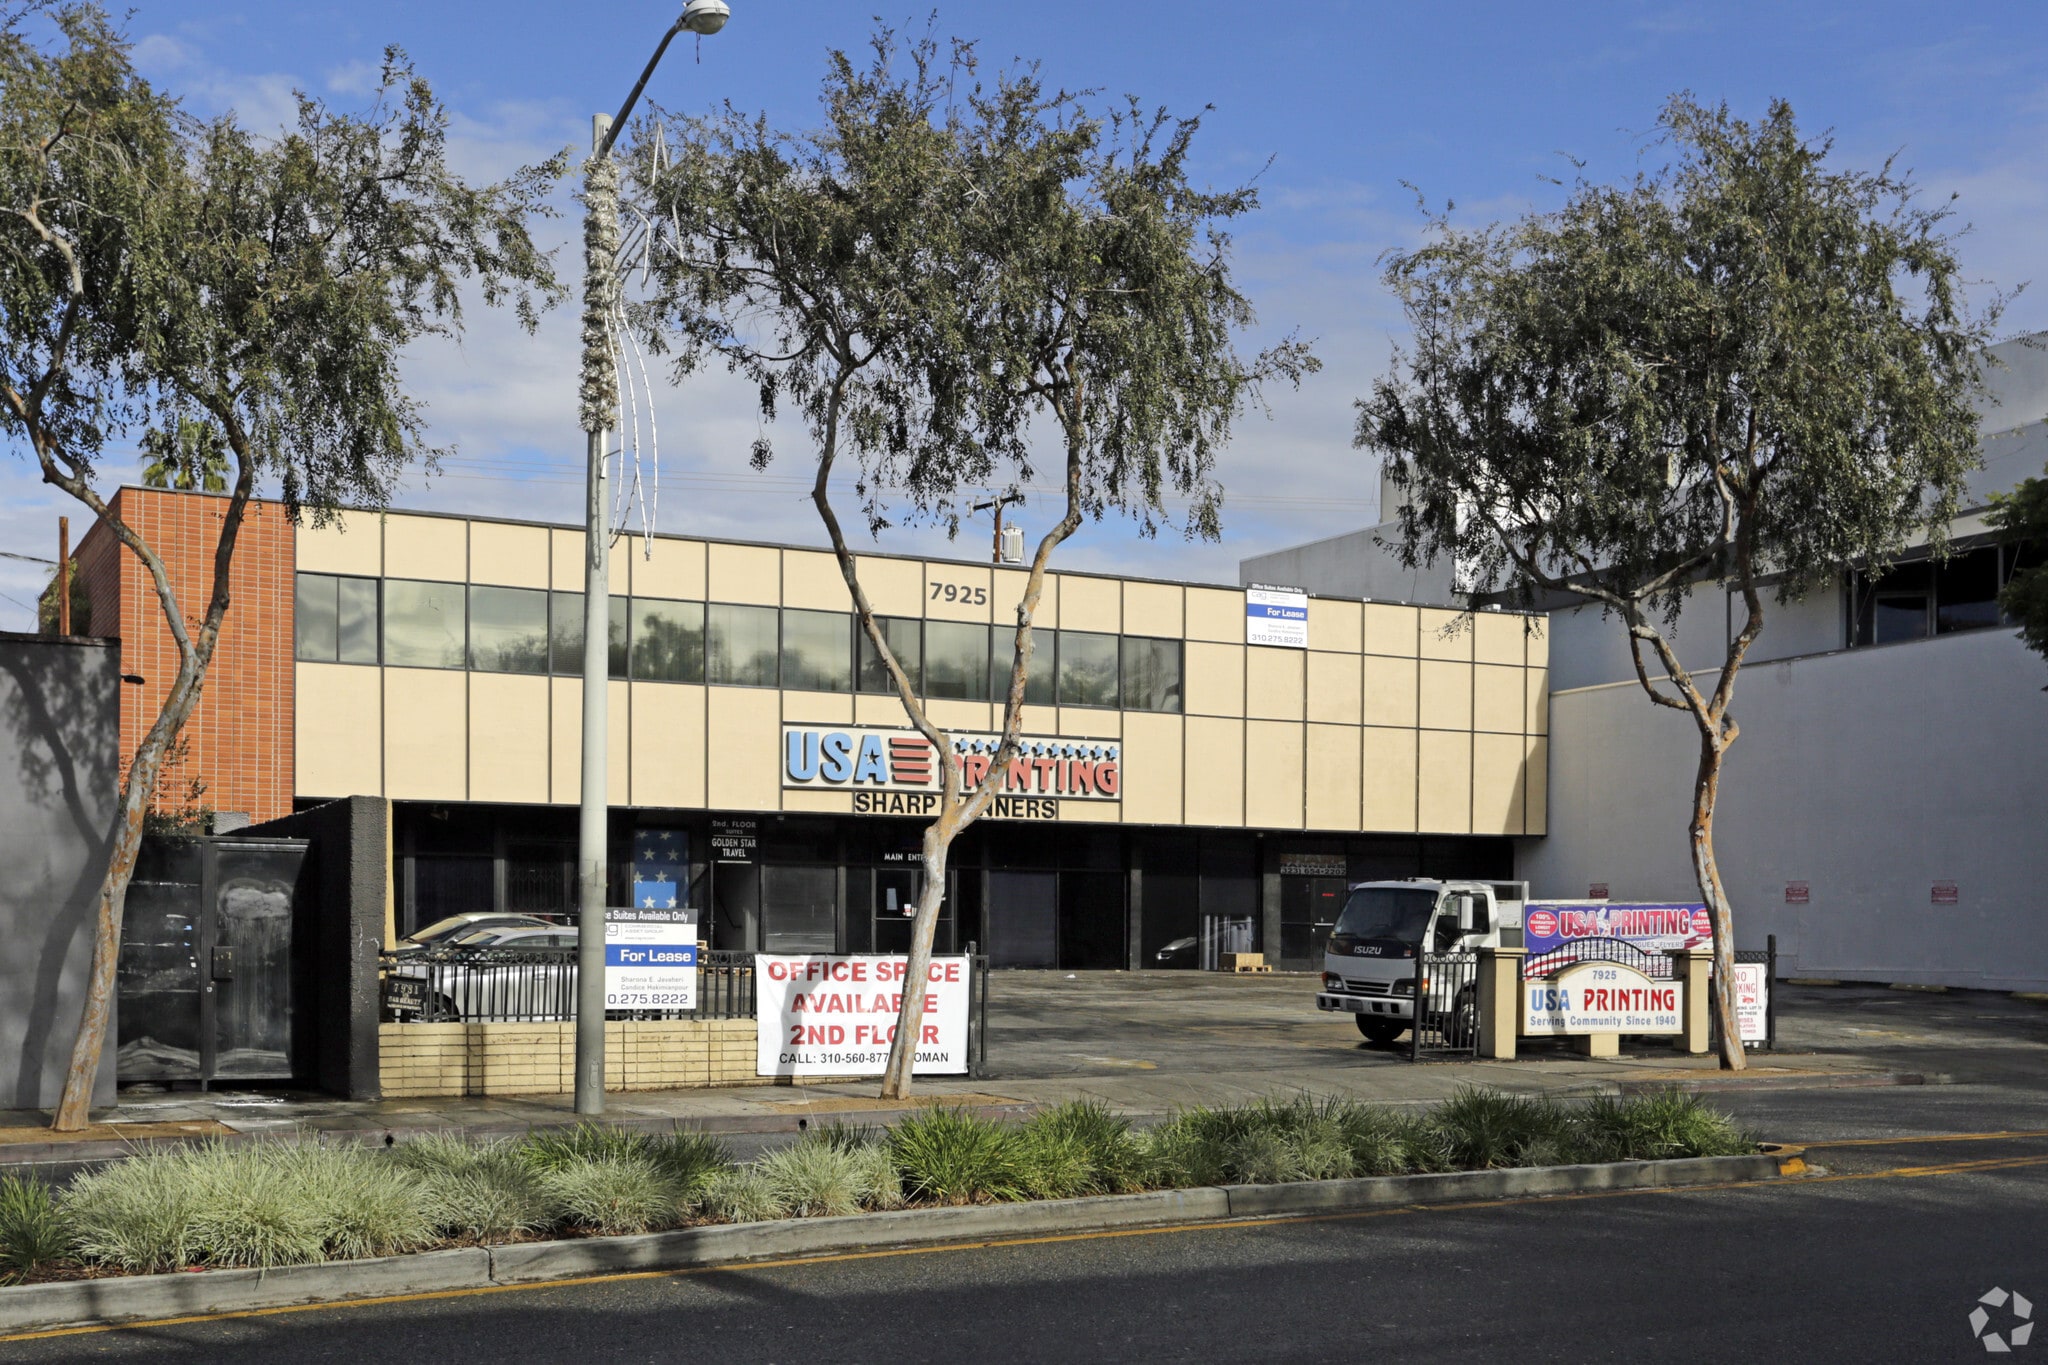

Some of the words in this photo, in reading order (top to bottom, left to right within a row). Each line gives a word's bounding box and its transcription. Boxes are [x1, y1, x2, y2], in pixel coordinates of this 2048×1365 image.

[930, 582, 986, 606] 7925
[1267, 608, 1281, 616] For
[1282, 608, 1304, 618] Lease
[787, 731, 888, 784] USA
[855, 793, 936, 814] SHARP
[712, 838, 738, 846] GOLDEN
[740, 839, 756, 848] STAR
[722, 848, 746, 857] TRAVEL
[884, 853, 903, 861] MAIN
[614, 910, 636, 920] Suites
[638, 911, 670, 920] Available
[672, 912, 688, 923] Only
[1558, 911, 1599, 938] USA
[1609, 909, 1690, 936] PRINTING
[620, 949, 646, 962] For
[649, 950, 692, 962] Lease
[1354, 946, 1382, 954] ISUZU
[768, 962, 867, 982] OFFICE
[876, 962, 960, 982] SPCE
[1592, 970, 1616, 980] 7925
[1734, 972, 1746, 982] NO
[608, 994, 688, 1004] 0.275.8222
[791, 993, 938, 1013] AVAILABE
[1532, 990, 1570, 1011] USA
[1584, 989, 1674, 1012] PRINTING
[1530, 1016, 1566, 1027] Serving
[1570, 1016, 1622, 1027] Community
[1626, 1016, 1650, 1026] Since
[1656, 1016, 1676, 1026] 1940
[790, 1026, 845, 1044] 2ND
[779, 1053, 816, 1064] CALL:
[914, 1052, 949, 1062] OMAN
